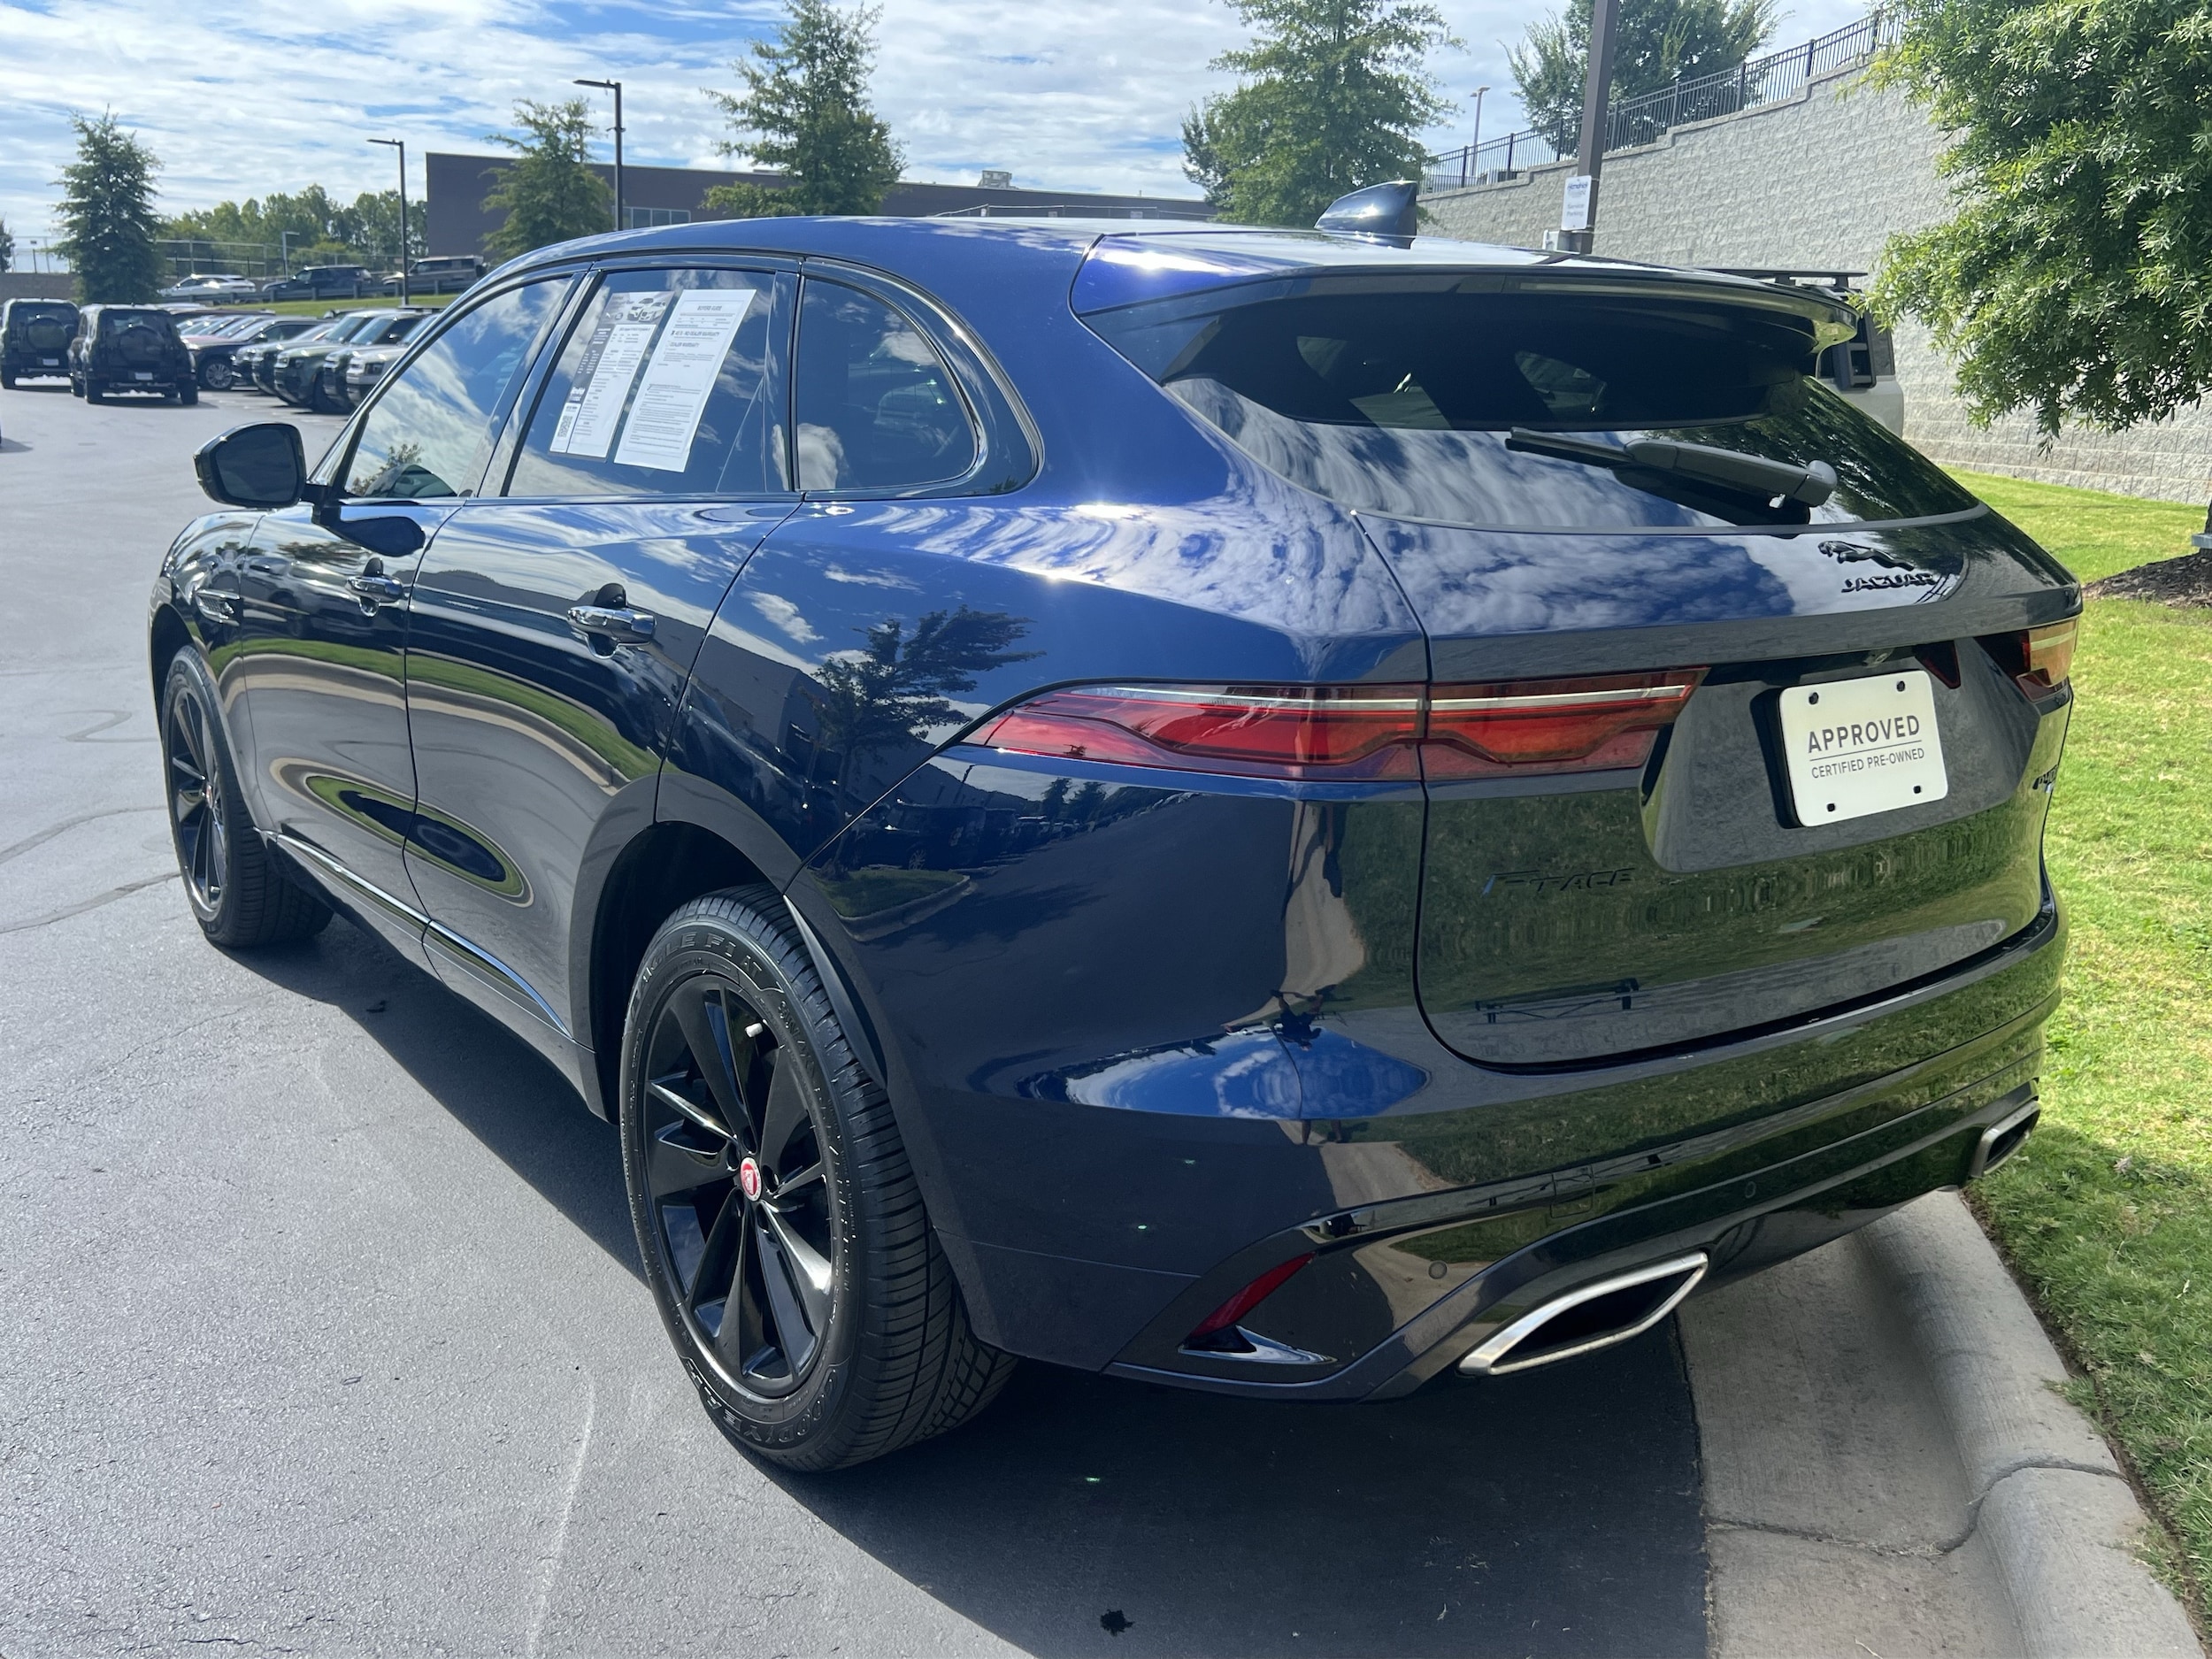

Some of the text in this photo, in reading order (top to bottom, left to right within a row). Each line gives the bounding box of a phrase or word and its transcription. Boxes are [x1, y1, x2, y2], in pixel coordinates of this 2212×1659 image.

[1841, 573, 1938, 594] JAGUAR
[1808, 714, 1921, 754] APPROVED
[1811, 748, 1925, 780] CERTIFIED PRE-OWNED
